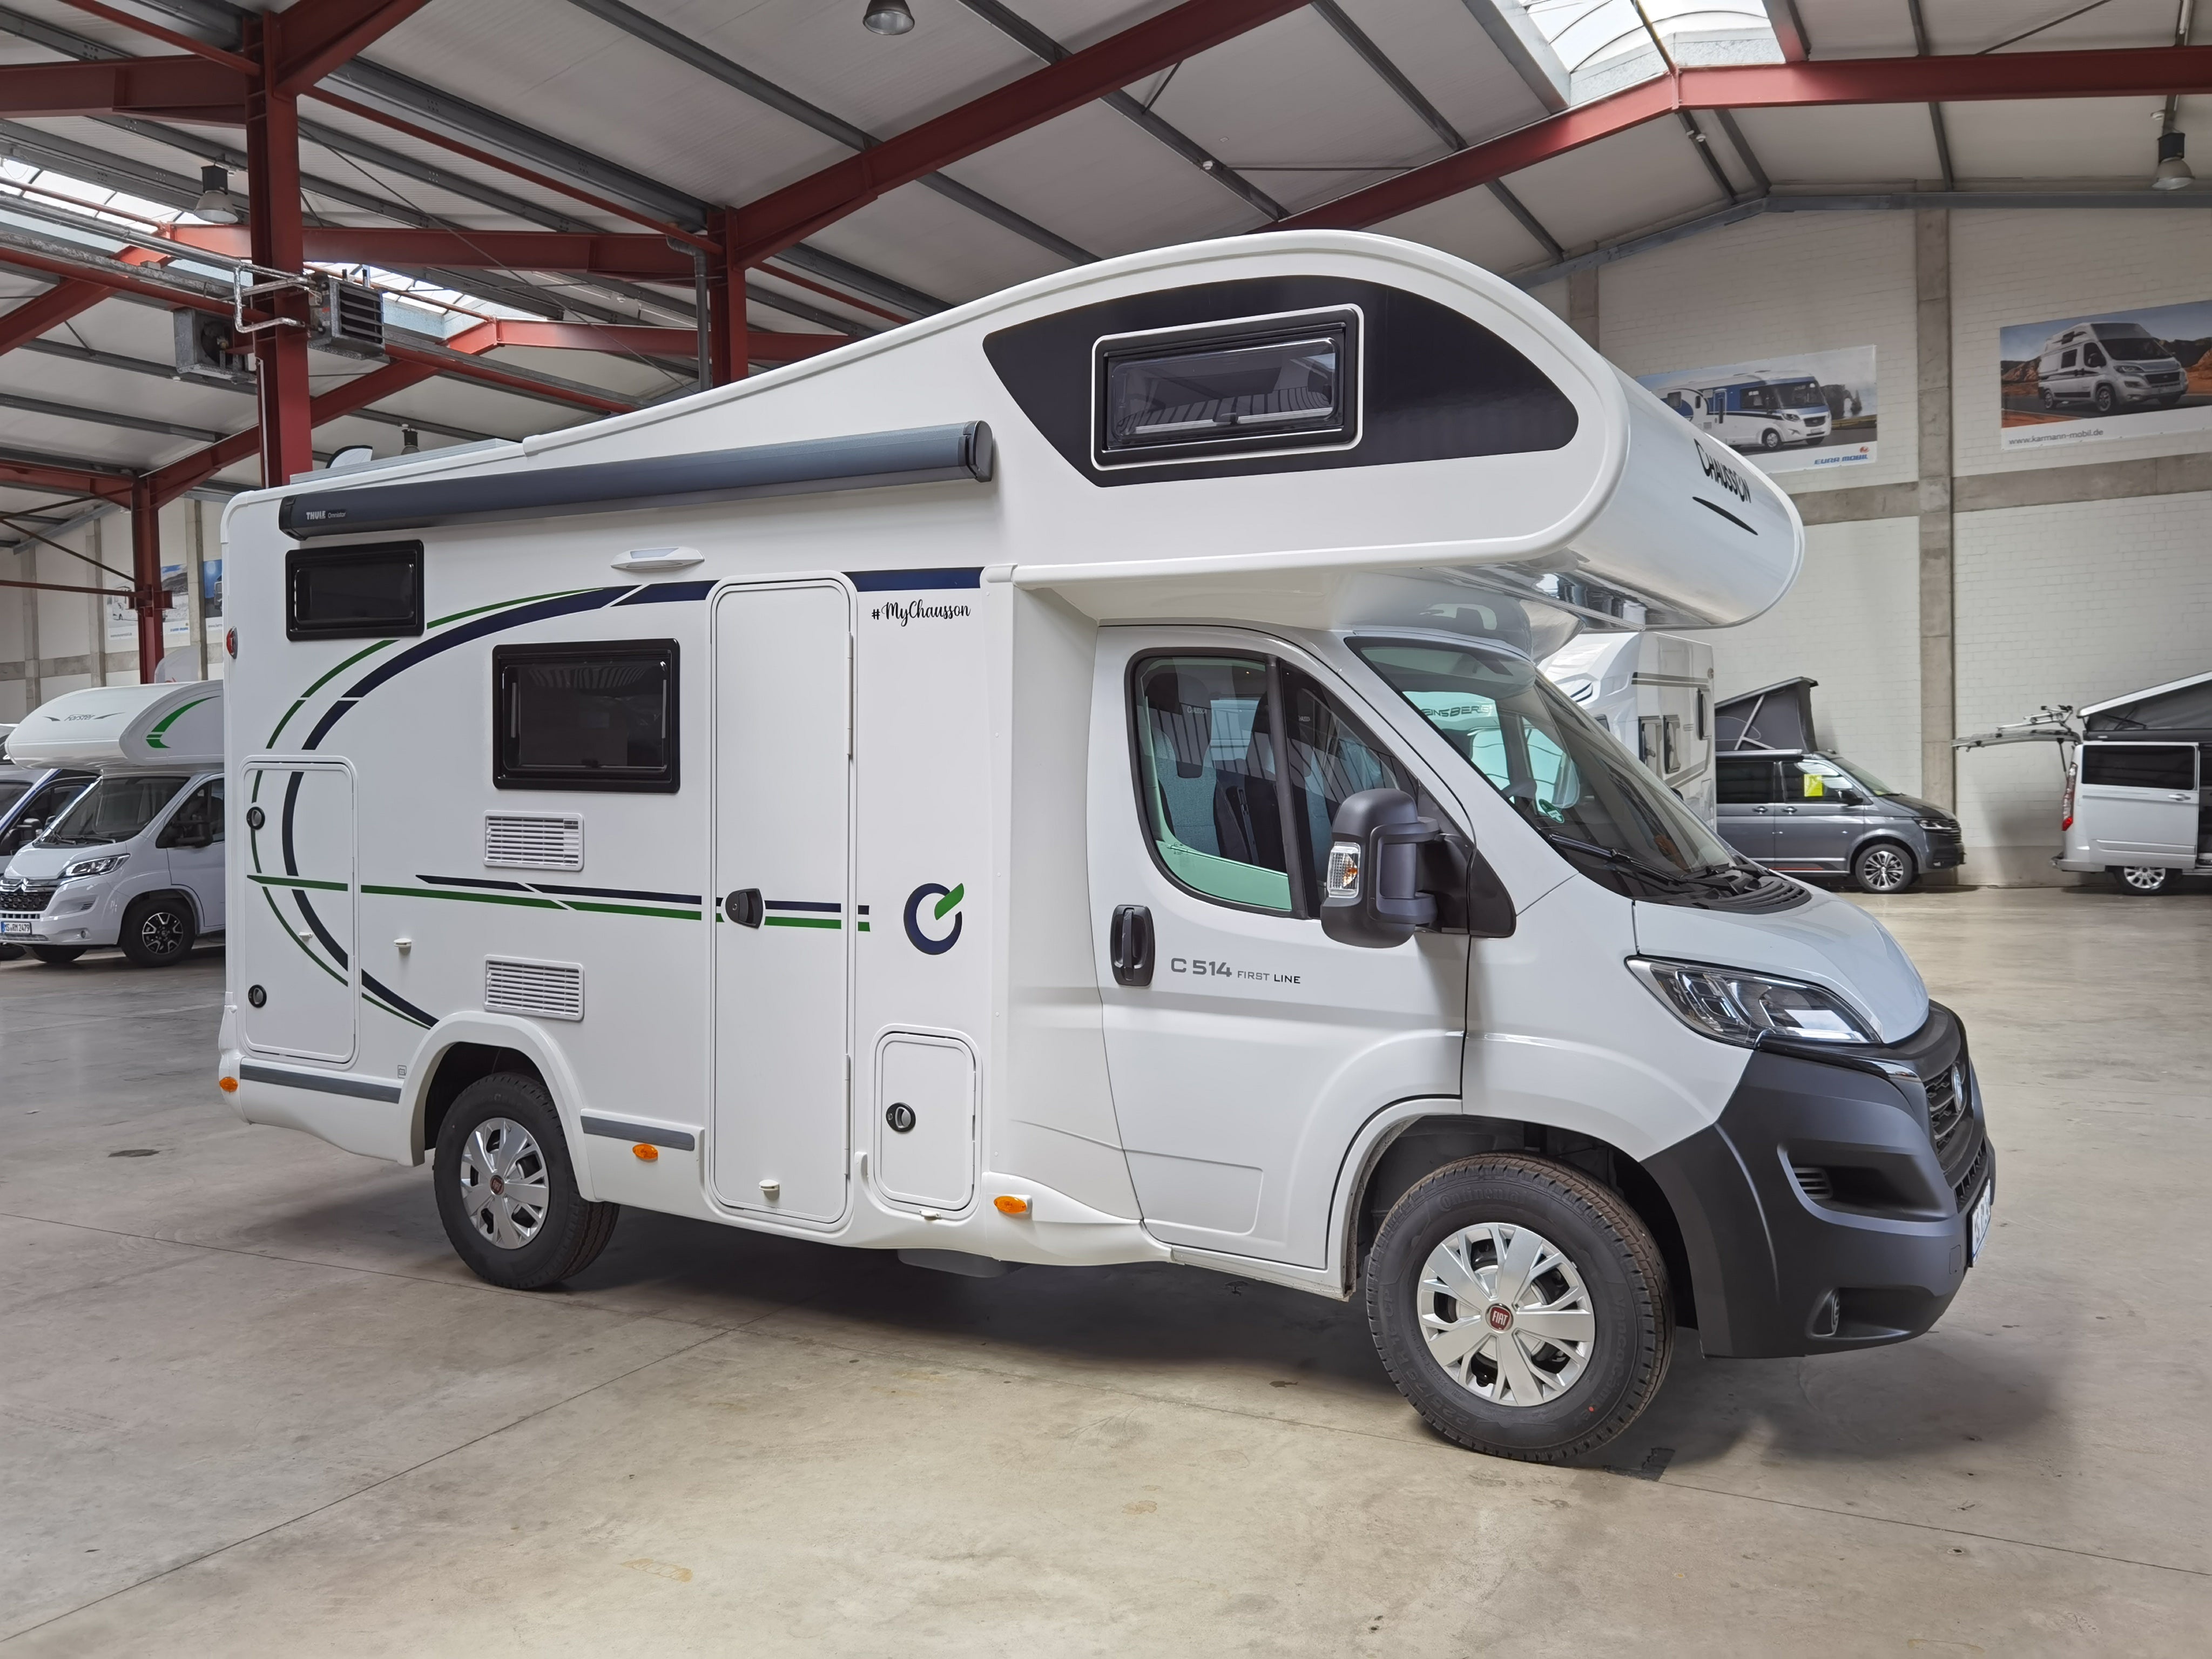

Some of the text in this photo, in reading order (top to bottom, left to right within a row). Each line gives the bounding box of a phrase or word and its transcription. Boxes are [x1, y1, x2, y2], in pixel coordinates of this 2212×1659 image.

[2009, 429, 2103, 444] www.karmann-mobil.de
[1842, 454, 1868, 462] MOBIL
[1694, 438, 1751, 503] CHAUSSON
[306, 510, 326, 520] THULE
[871, 599, 971, 627] #MyChausson
[1171, 957, 1300, 984] C 514 FIRST LINE
[1492, 1311, 1508, 1326] FIAT
